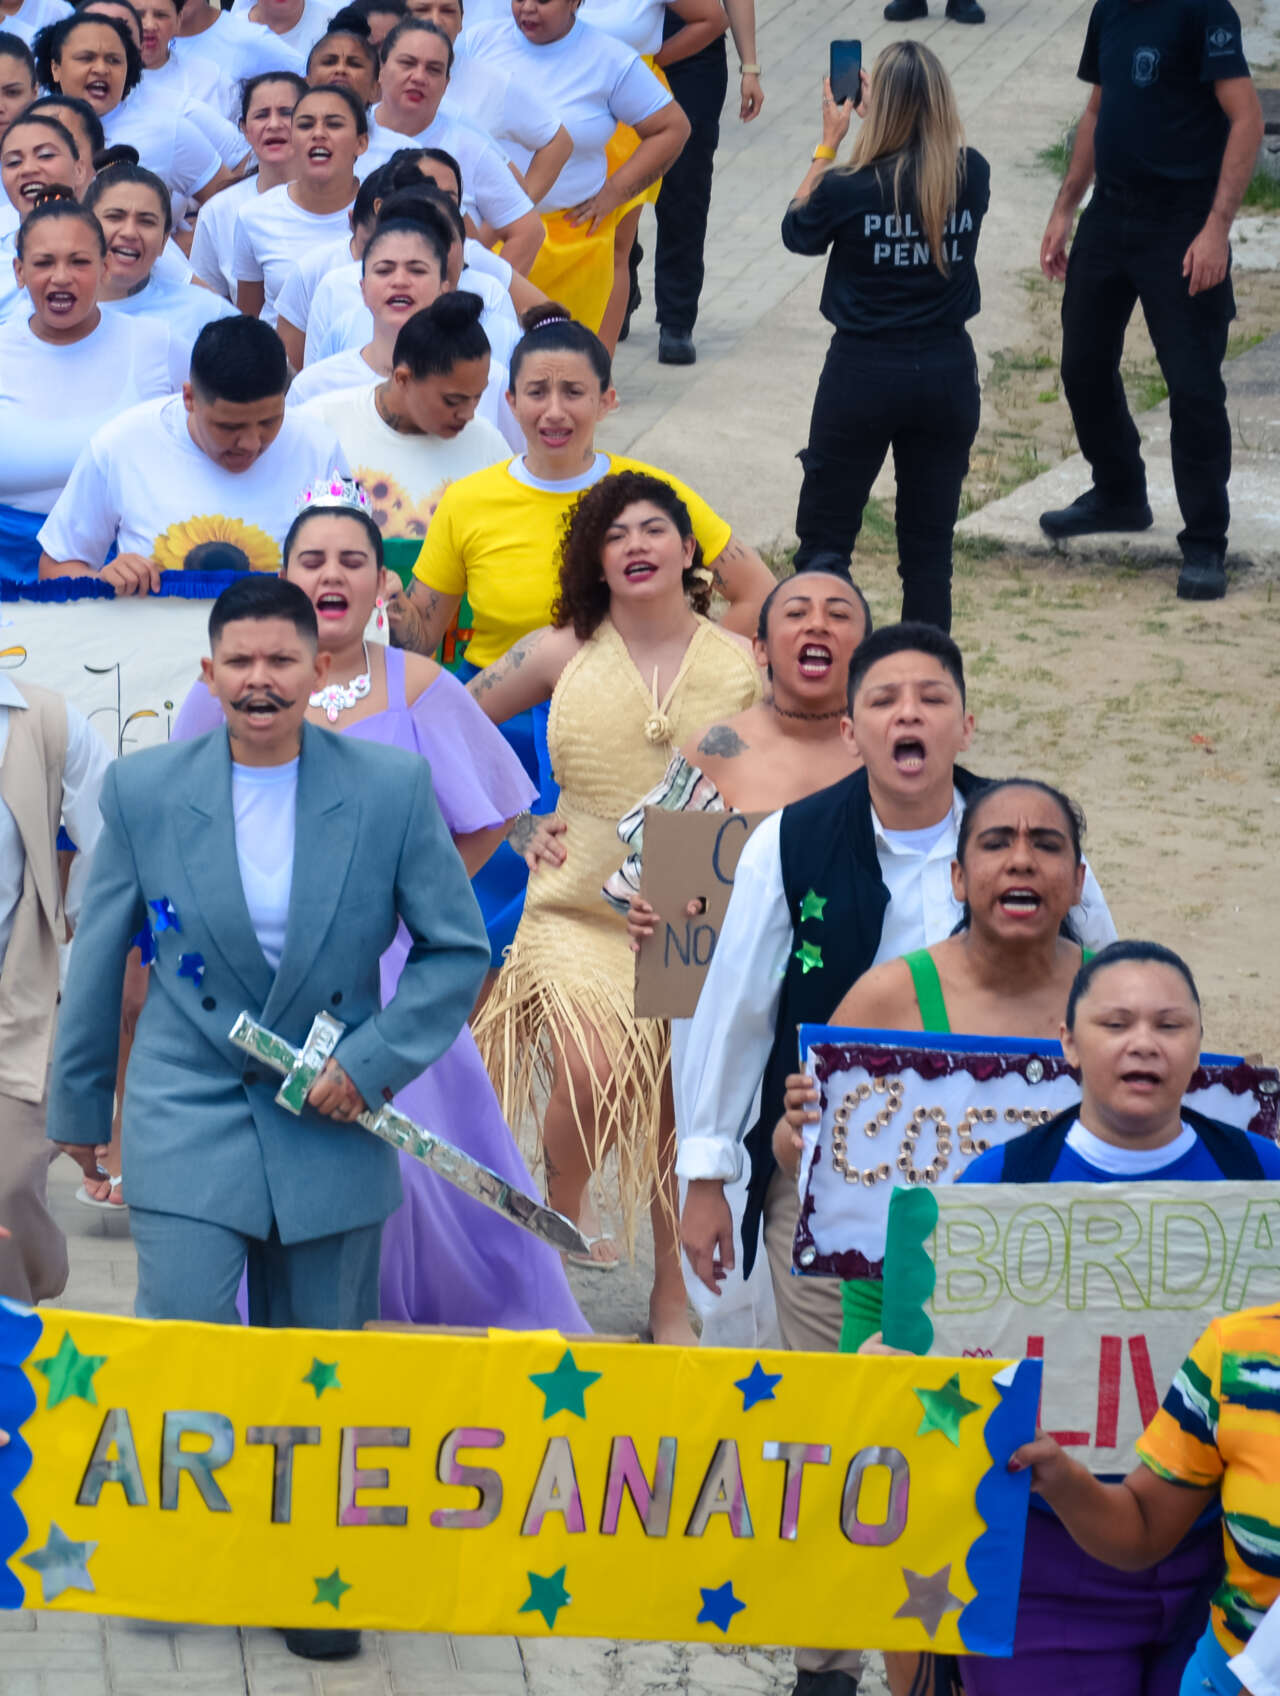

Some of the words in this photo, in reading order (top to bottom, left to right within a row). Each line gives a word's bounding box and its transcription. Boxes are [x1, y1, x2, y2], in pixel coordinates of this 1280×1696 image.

[864, 209, 973, 238] POLIA
[874, 240, 963, 266] PENL
[74, 1407, 911, 1547] ARTESANATO
